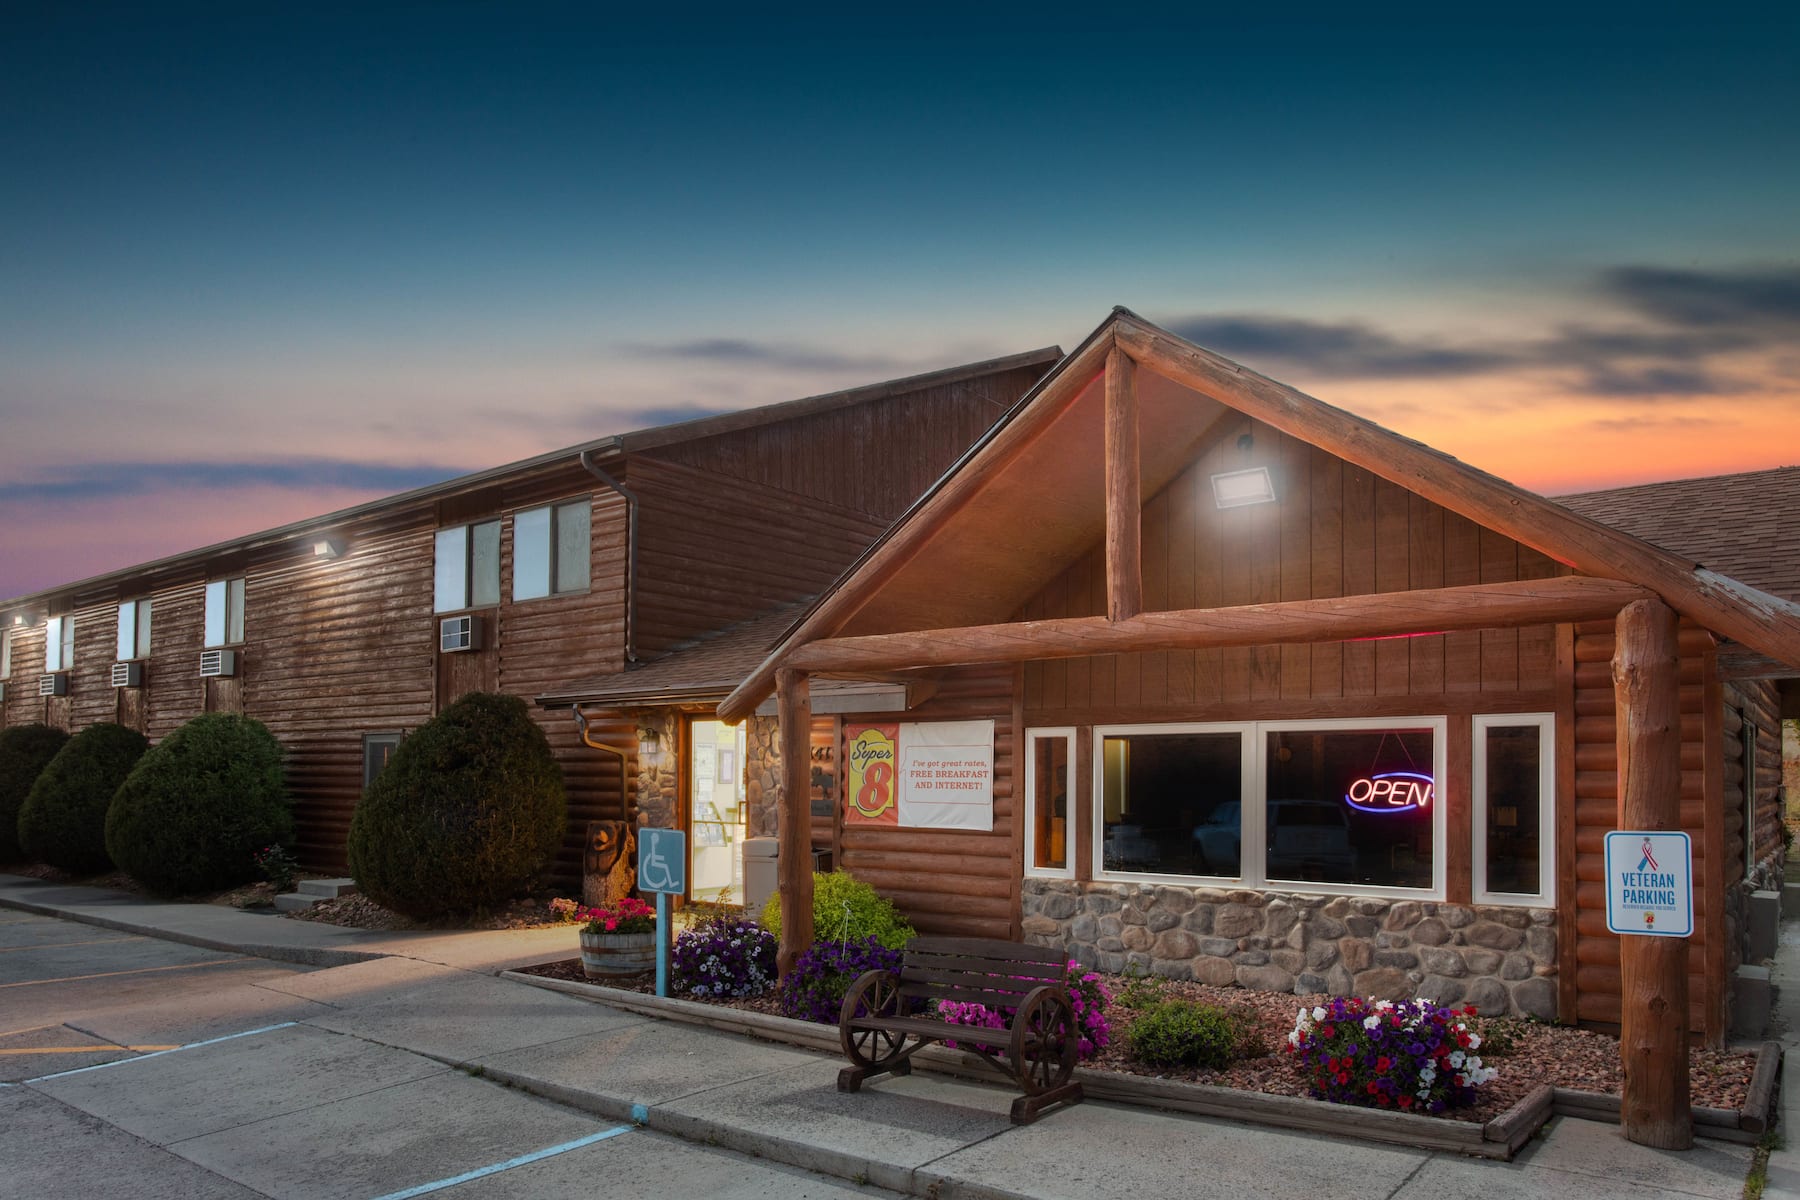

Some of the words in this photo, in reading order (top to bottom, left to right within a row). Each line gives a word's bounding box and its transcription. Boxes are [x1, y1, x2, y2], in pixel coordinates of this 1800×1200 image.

[852, 740, 892, 769] Super
[910, 770, 933, 778] FREE
[935, 770, 989, 778] BREAKFAST
[856, 761, 892, 812] 8
[915, 781, 933, 789] AND
[935, 781, 983, 790] INTERNET!
[1349, 778, 1432, 807] OPEN
[1622, 872, 1675, 888] VETERAN
[1623, 889, 1675, 905] PARKING
